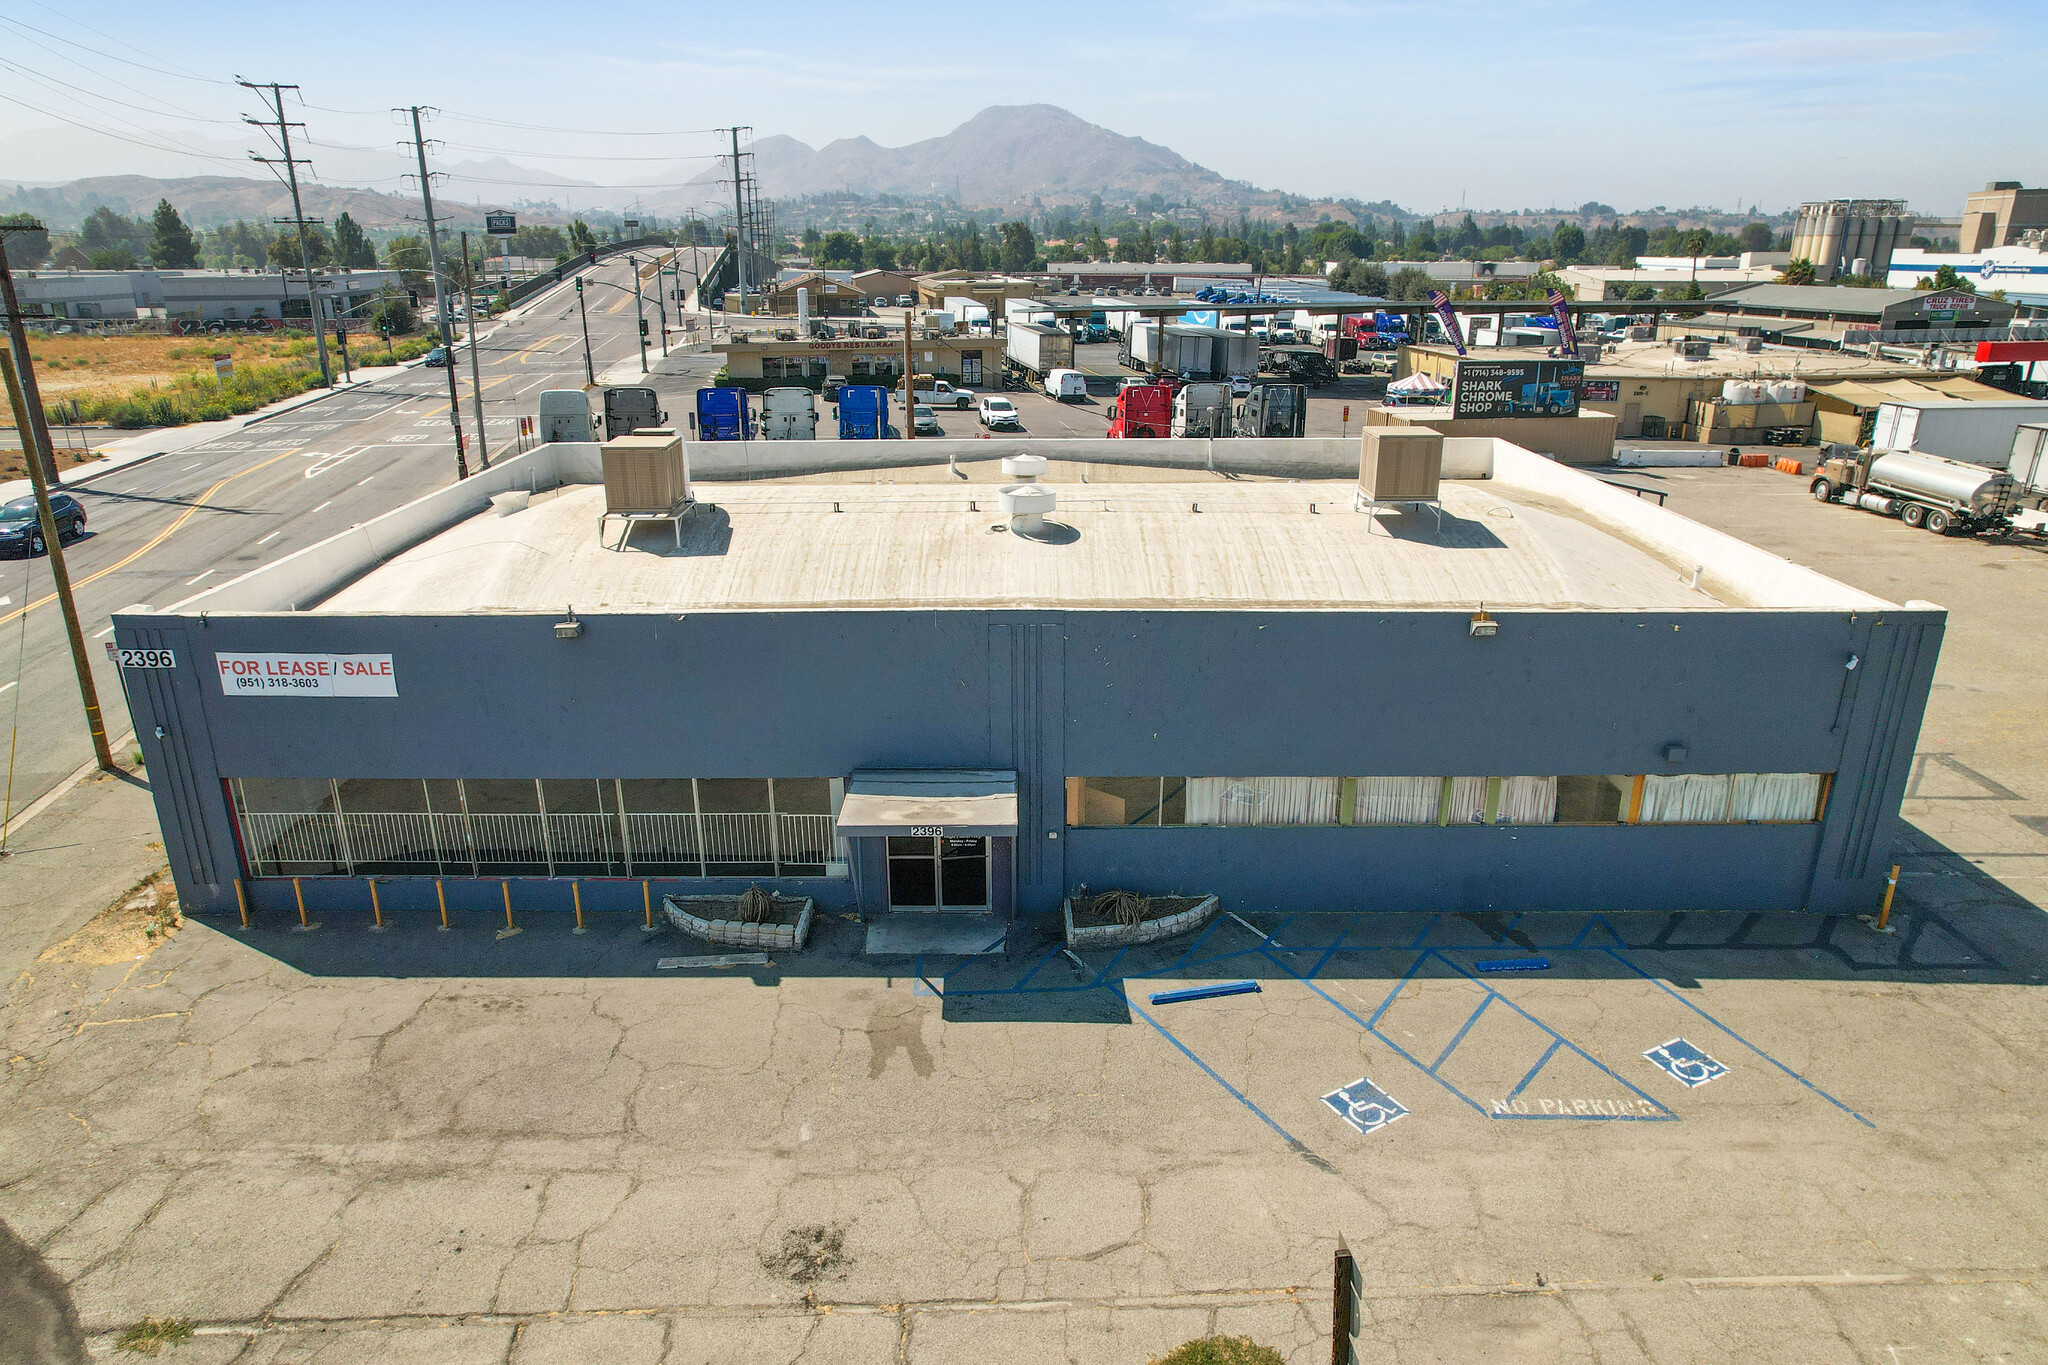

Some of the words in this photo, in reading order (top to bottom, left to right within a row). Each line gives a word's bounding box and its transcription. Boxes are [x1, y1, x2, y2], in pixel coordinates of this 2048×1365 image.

[1447, 324, 1462, 350] CHROME
[1558, 323, 1569, 349] CHROME
[1463, 369, 1471, 377] +1
[1471, 368, 1490, 378] (714)
[1490, 368, 1525, 377] 348-9595
[1461, 380, 1503, 391] SHARK
[1460, 391, 1513, 402] CHROME
[1754, 390, 1761, 399] 2
[1459, 402, 1493, 413] SHOP
[386, 434, 430, 443] KEEP
[121, 650, 173, 668] 2396
[219, 660, 262, 676] FOR
[266, 660, 331, 677] LEASE
[343, 660, 393, 676] SALE
[236, 677, 266, 690] (951)
[268, 677, 320, 689] 318-3603
[912, 826, 942, 836] 2396
[1490, 1098, 1529, 1115] NO
